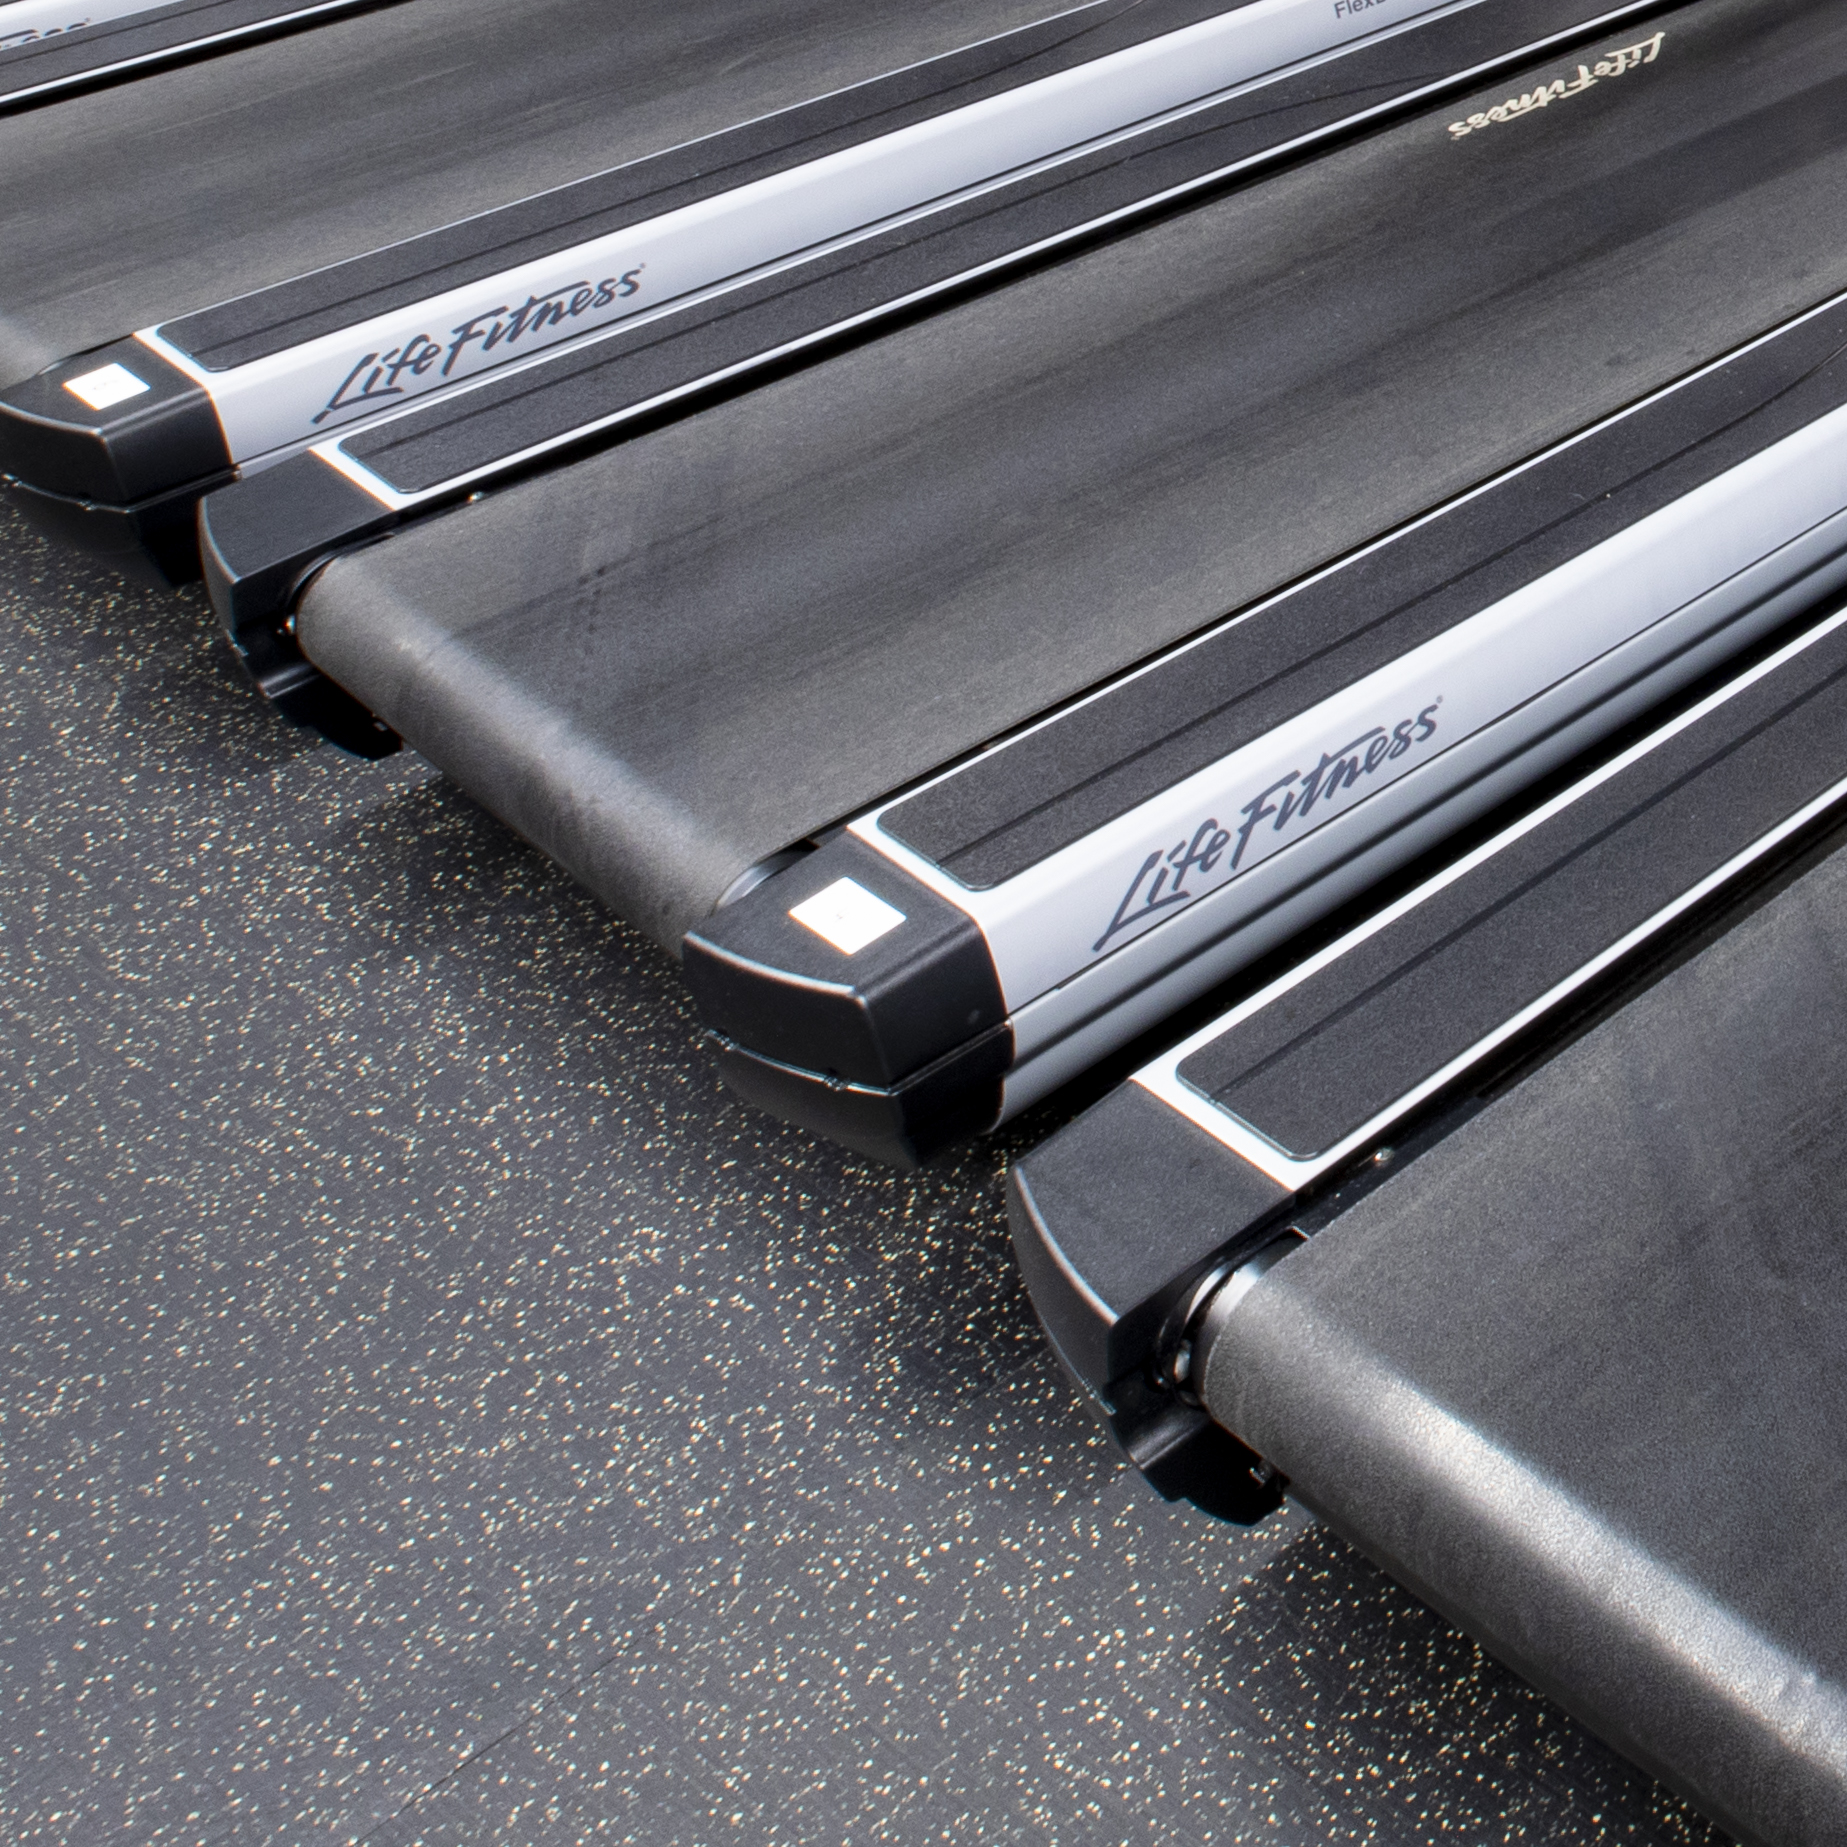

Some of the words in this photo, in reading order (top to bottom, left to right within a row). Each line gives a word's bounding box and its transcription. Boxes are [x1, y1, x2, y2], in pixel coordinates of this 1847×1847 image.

[1448, 64, 1599, 136] Fitness
[1593, 31, 1666, 77] Life
[311, 330, 441, 427] Life
[439, 264, 643, 378] Fitness
[1092, 818, 1228, 953] Life
[1230, 695, 1440, 872] Fitness
